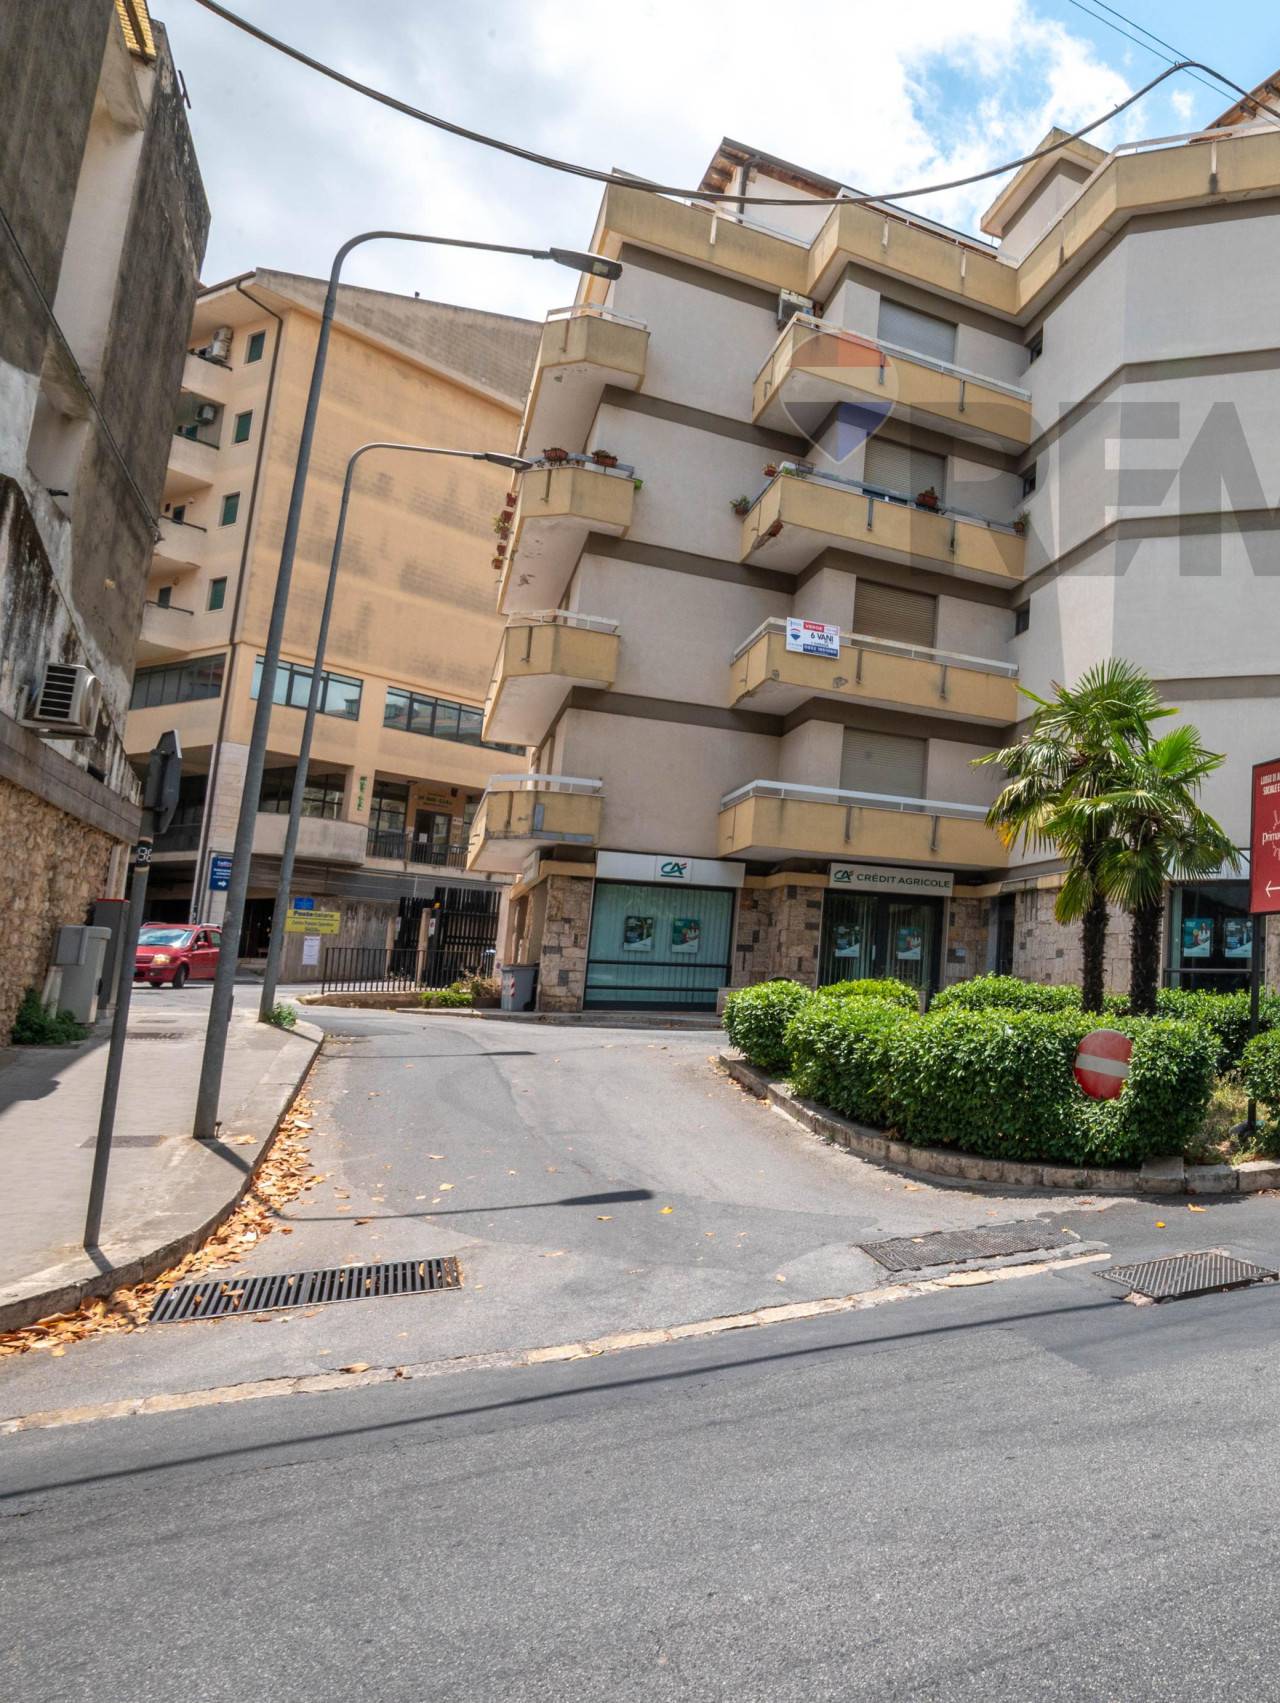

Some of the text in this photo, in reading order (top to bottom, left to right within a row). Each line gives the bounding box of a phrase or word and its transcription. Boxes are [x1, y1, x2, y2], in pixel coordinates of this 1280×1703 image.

[817, 633, 834, 642] VANI
[857, 872, 896, 884] CRÉDIT
[898, 877, 950, 888] AGRICOLE
